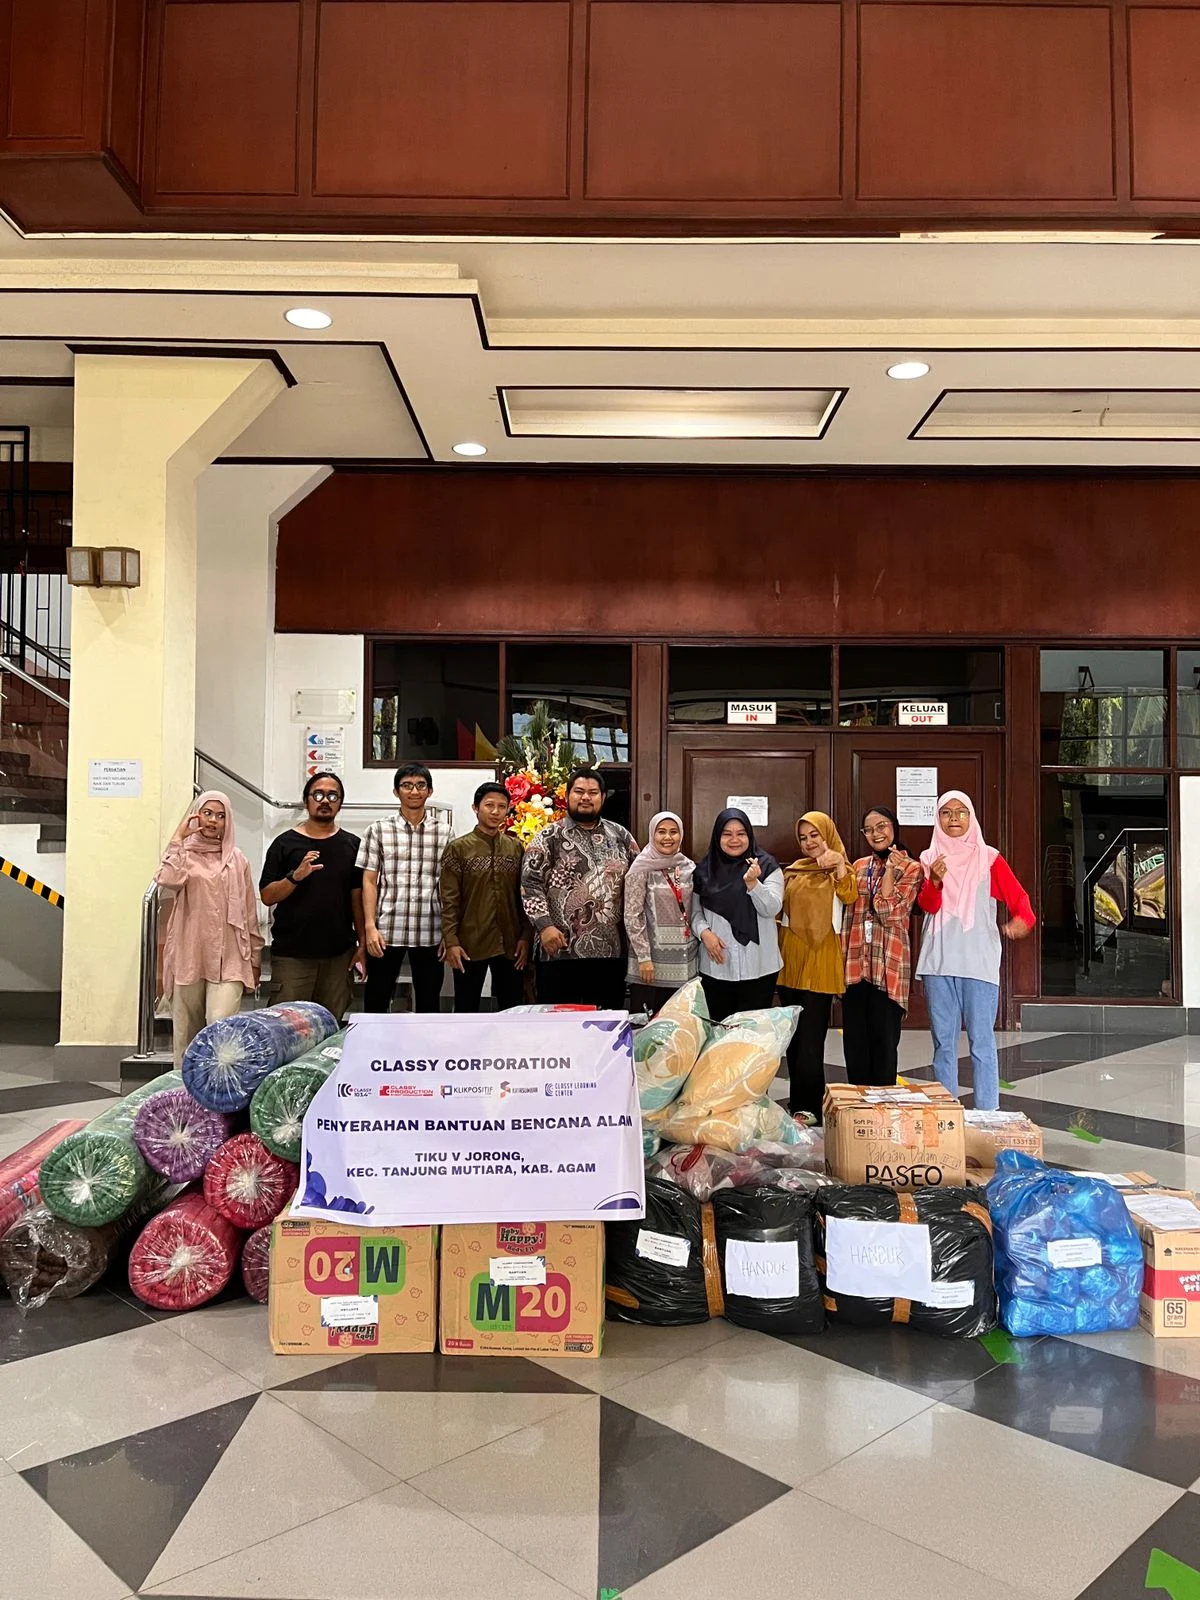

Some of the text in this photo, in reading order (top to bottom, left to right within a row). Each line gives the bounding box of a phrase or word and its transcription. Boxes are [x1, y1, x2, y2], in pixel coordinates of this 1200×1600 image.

[730, 703, 773, 712] MASUK
[901, 705, 945, 713] KELUAR
[745, 714, 758, 722] IN
[911, 715, 933, 723] OUT
[370, 1057, 571, 1072] CLASSY CORPORATION
[454, 1086, 493, 1094] KLIKPOSITIF
[316, 1115, 633, 1132] PENYERAHAN BANTUAN BENCANA ALAM
[415, 1151, 525, 1163] TIKU V JORONG,
[911, 1145, 937, 1164] Dalam
[346, 1162, 596, 1178] KEC. TANJUNG MUTIARA, KAB. AGAM
[866, 1164, 943, 1186] PASEO
[500, 1230, 544, 1245] Happy!
[850, 1244, 905, 1265] HANDUK
[308, 1246, 399, 1283] M 20
[742, 1260, 789, 1276] HANDUK
[476, 1283, 567, 1321] M 20
[1167, 1302, 1183, 1314] 65
[331, 1325, 376, 1337] Happy!
